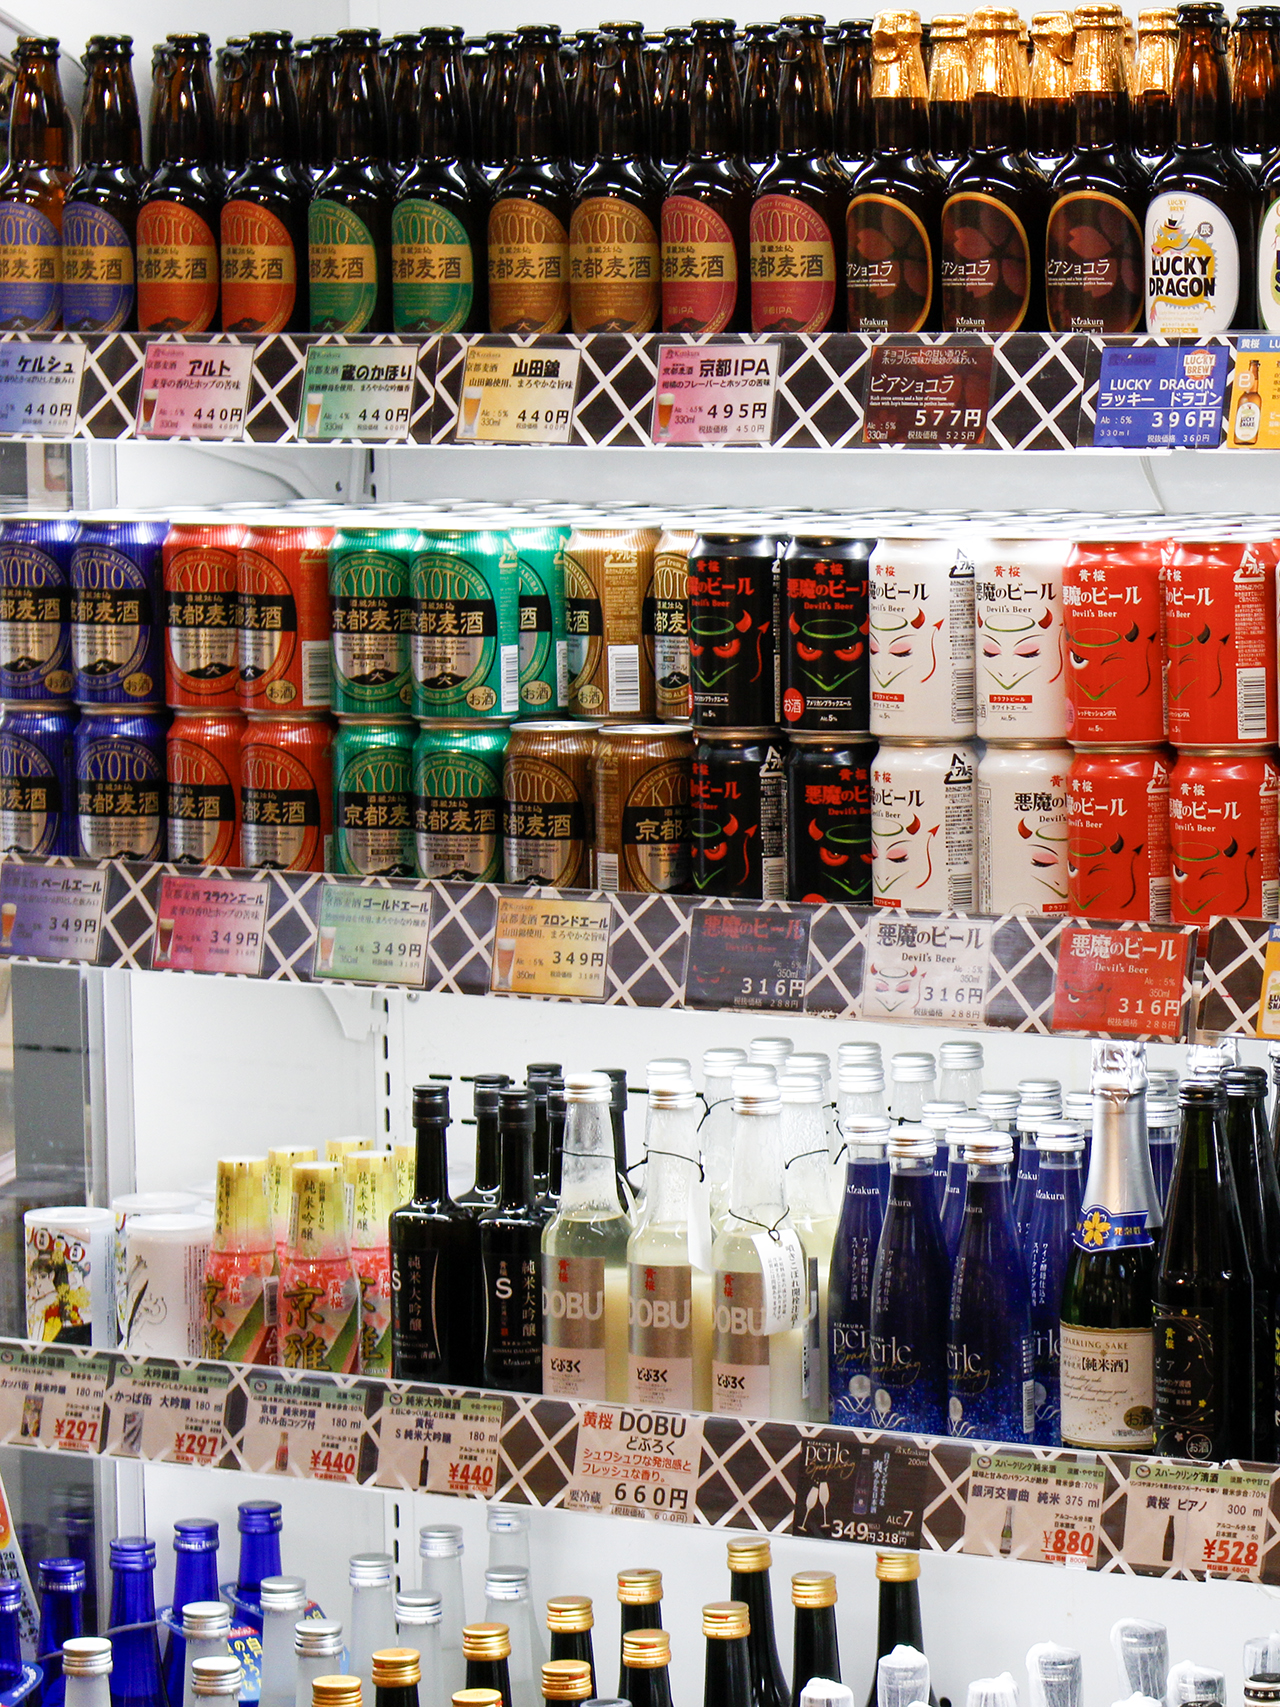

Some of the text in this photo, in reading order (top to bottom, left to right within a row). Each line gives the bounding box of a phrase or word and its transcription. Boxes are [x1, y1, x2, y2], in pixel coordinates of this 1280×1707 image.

[1200, 224, 1212, 236] 辰
[1152, 256, 1211, 276] LUCKY
[1149, 278, 1215, 297] DRAGON
[1071, 317, 1103, 327] Kizakura
[1241, 338, 1260, 350] 黄桜
[16, 355, 74, 373] ケルシュ
[186, 359, 231, 376] アルト
[512, 360, 561, 378] 山田錦
[699, 359, 770, 378] 京都IPA
[341, 365, 412, 381] 蔵のかほり
[870, 375, 955, 393] ビアショコラ
[1110, 378, 1213, 391] LUCKY DRAGON
[24, 404, 72, 417] 440円
[194, 407, 242, 422] 440円
[359, 409, 409, 423] 440円
[517, 410, 568, 423] 440円
[708, 404, 766, 419] 495円
[915, 410, 981, 427] 577円
[1151, 411, 1216, 428] 396円
[1079, 569, 1106, 582] 黄桜
[976, 582, 1056, 601] 悪魔のビール
[986, 605, 1011, 614] Devil's
[1098, 610, 1117, 618] Beer
[41, 880, 102, 892] ペールエール
[203, 891, 264, 905] ブラウンエール
[362, 899, 429, 913] ゴールドエール
[50, 918, 96, 932] 349円
[541, 915, 608, 929] ブロンドエール
[211, 931, 258, 946] 349円
[877, 923, 983, 949] 悪魔のビール
[372, 942, 422, 957] 349円
[1071, 933, 1176, 962] 悪魔のビール
[552, 951, 604, 967] 349円
[742, 978, 805, 997] 316円
[924, 987, 983, 1004] 316円
[1119, 999, 1180, 1017] 316円
[628, 1298, 691, 1328] DOBU
[550, 1358, 581, 1374] どぶろく
[54, 1419, 98, 1442] ¥297
[582, 1411, 686, 1438] 黄桜 DOBU
[310, 1450, 355, 1473] ¥440
[583, 1448, 692, 1472] シュワシュワな発泡感と
[614, 1483, 688, 1509] 660円
[971, 1484, 1030, 1503] 銀河交響曲
[1042, 1529, 1094, 1554] ¥880
[1203, 1538, 1259, 1564] ¥528
